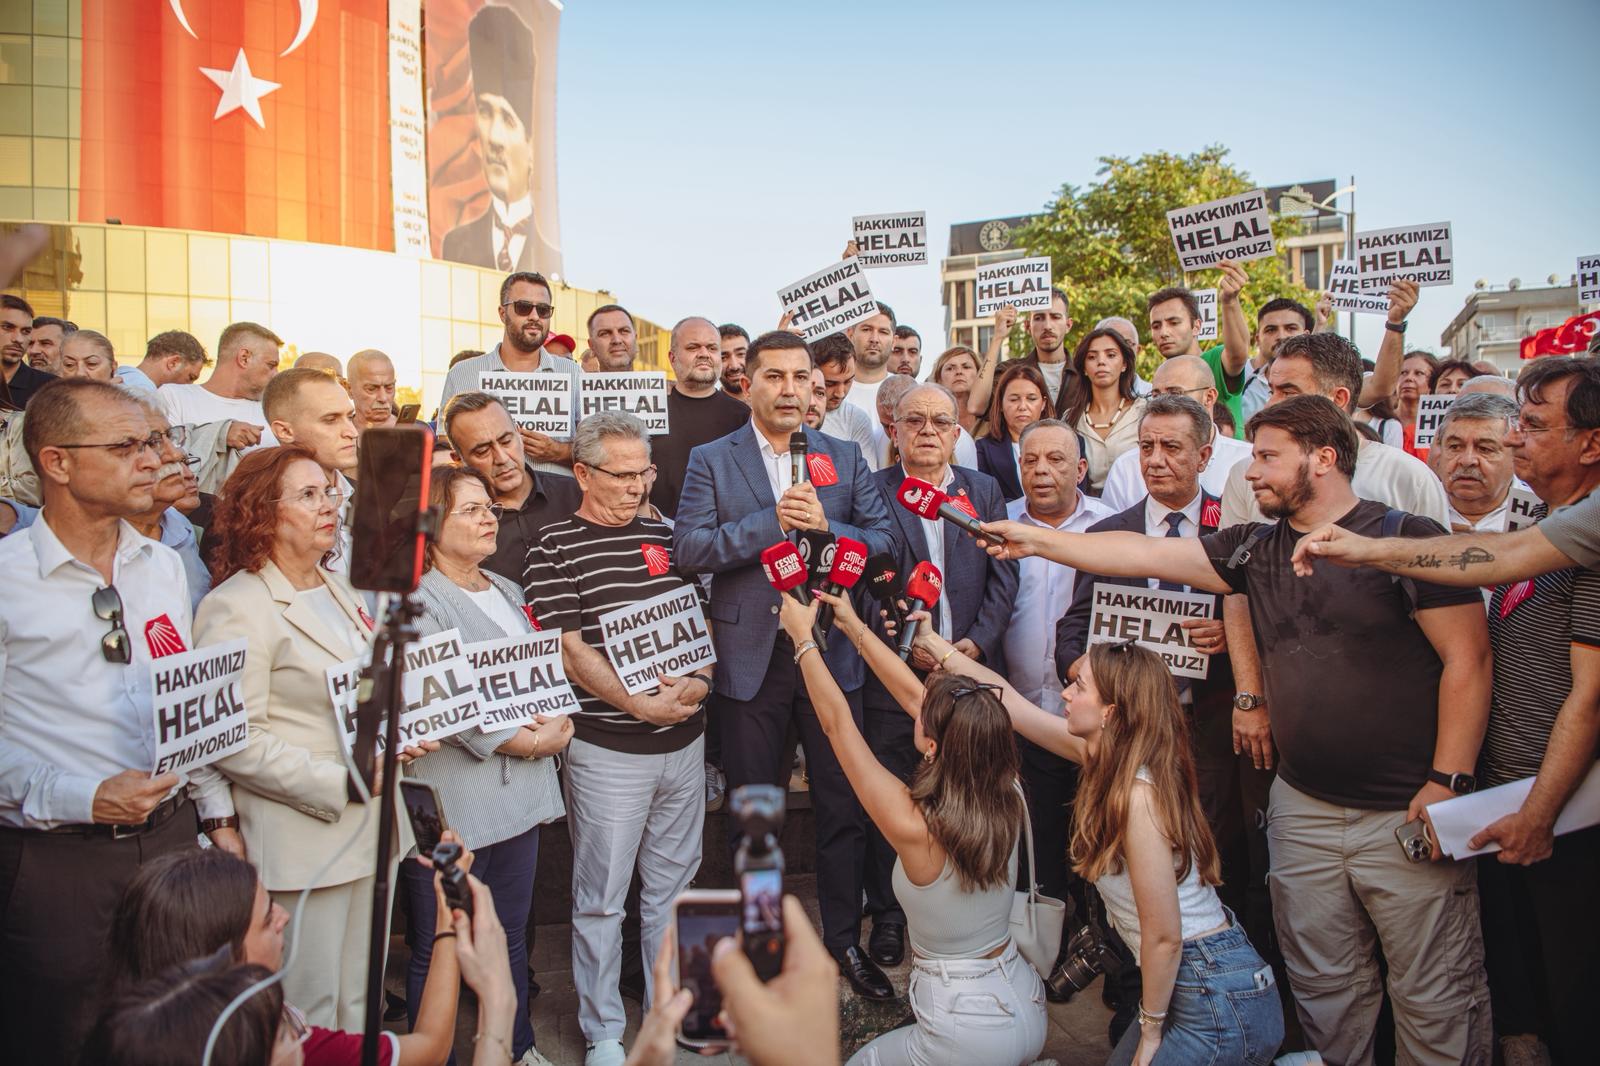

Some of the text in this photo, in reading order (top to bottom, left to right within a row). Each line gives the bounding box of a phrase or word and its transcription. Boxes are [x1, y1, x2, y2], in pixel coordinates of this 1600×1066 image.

[854, 217, 924, 232] HAKKIMIZI
[1171, 197, 1263, 230] HAKKIMIZI
[856, 232, 925, 252] HELAL
[1176, 218, 1270, 252] HELAL
[1358, 228, 1449, 250] HAKKIMIZI
[1183, 240, 1272, 267] ETMİYORUZ!
[1360, 247, 1451, 273] HELAL
[781, 262, 860, 307] HAKKIMIZI
[979, 262, 1049, 282] HAKKIMIZI
[978, 276, 1050, 301] HELAL
[791, 281, 870, 327] HELAL
[481, 378, 569, 392] HAKKIMIZI
[581, 378, 665, 392] HAKKIMIZI
[503, 396, 569, 416] ELAL
[774, 552, 799, 570] CESUR
[605, 592, 698, 639] HAKKIMIZI
[1096, 590, 1211, 618] HAKKIMIZI
[466, 638, 560, 670] HAKKIMIZI
[610, 616, 707, 669] HELAL
[156, 650, 247, 697] HAKKIMIZI
[623, 643, 713, 688] ETMİYORUZ!
[158, 682, 245, 745] HELAL
[155, 722, 247, 777] ETMİYORUZ!
